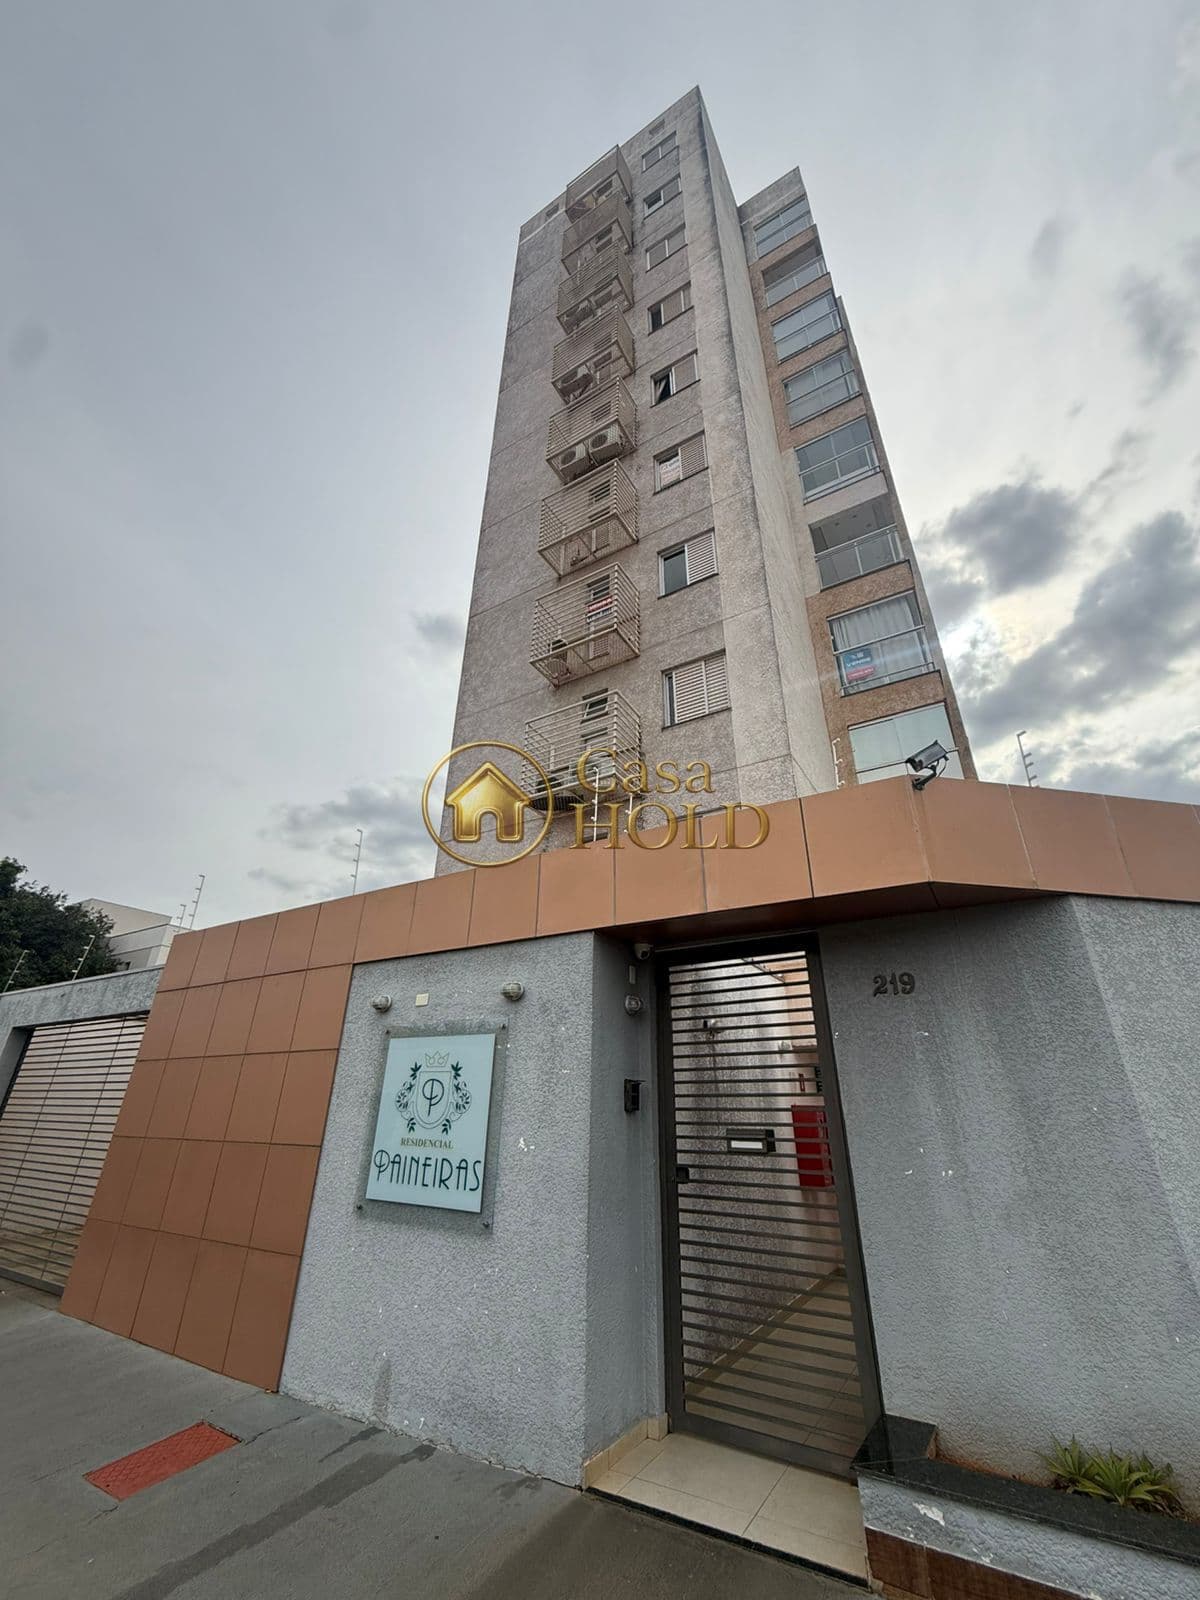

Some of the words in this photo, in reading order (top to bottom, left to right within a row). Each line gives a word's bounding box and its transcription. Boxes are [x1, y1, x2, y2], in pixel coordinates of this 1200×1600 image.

[873, 972, 915, 997] 219
[400, 1137, 454, 1150] RESIDENCIAL
[374, 1150, 482, 1192] PAINEIRAS
